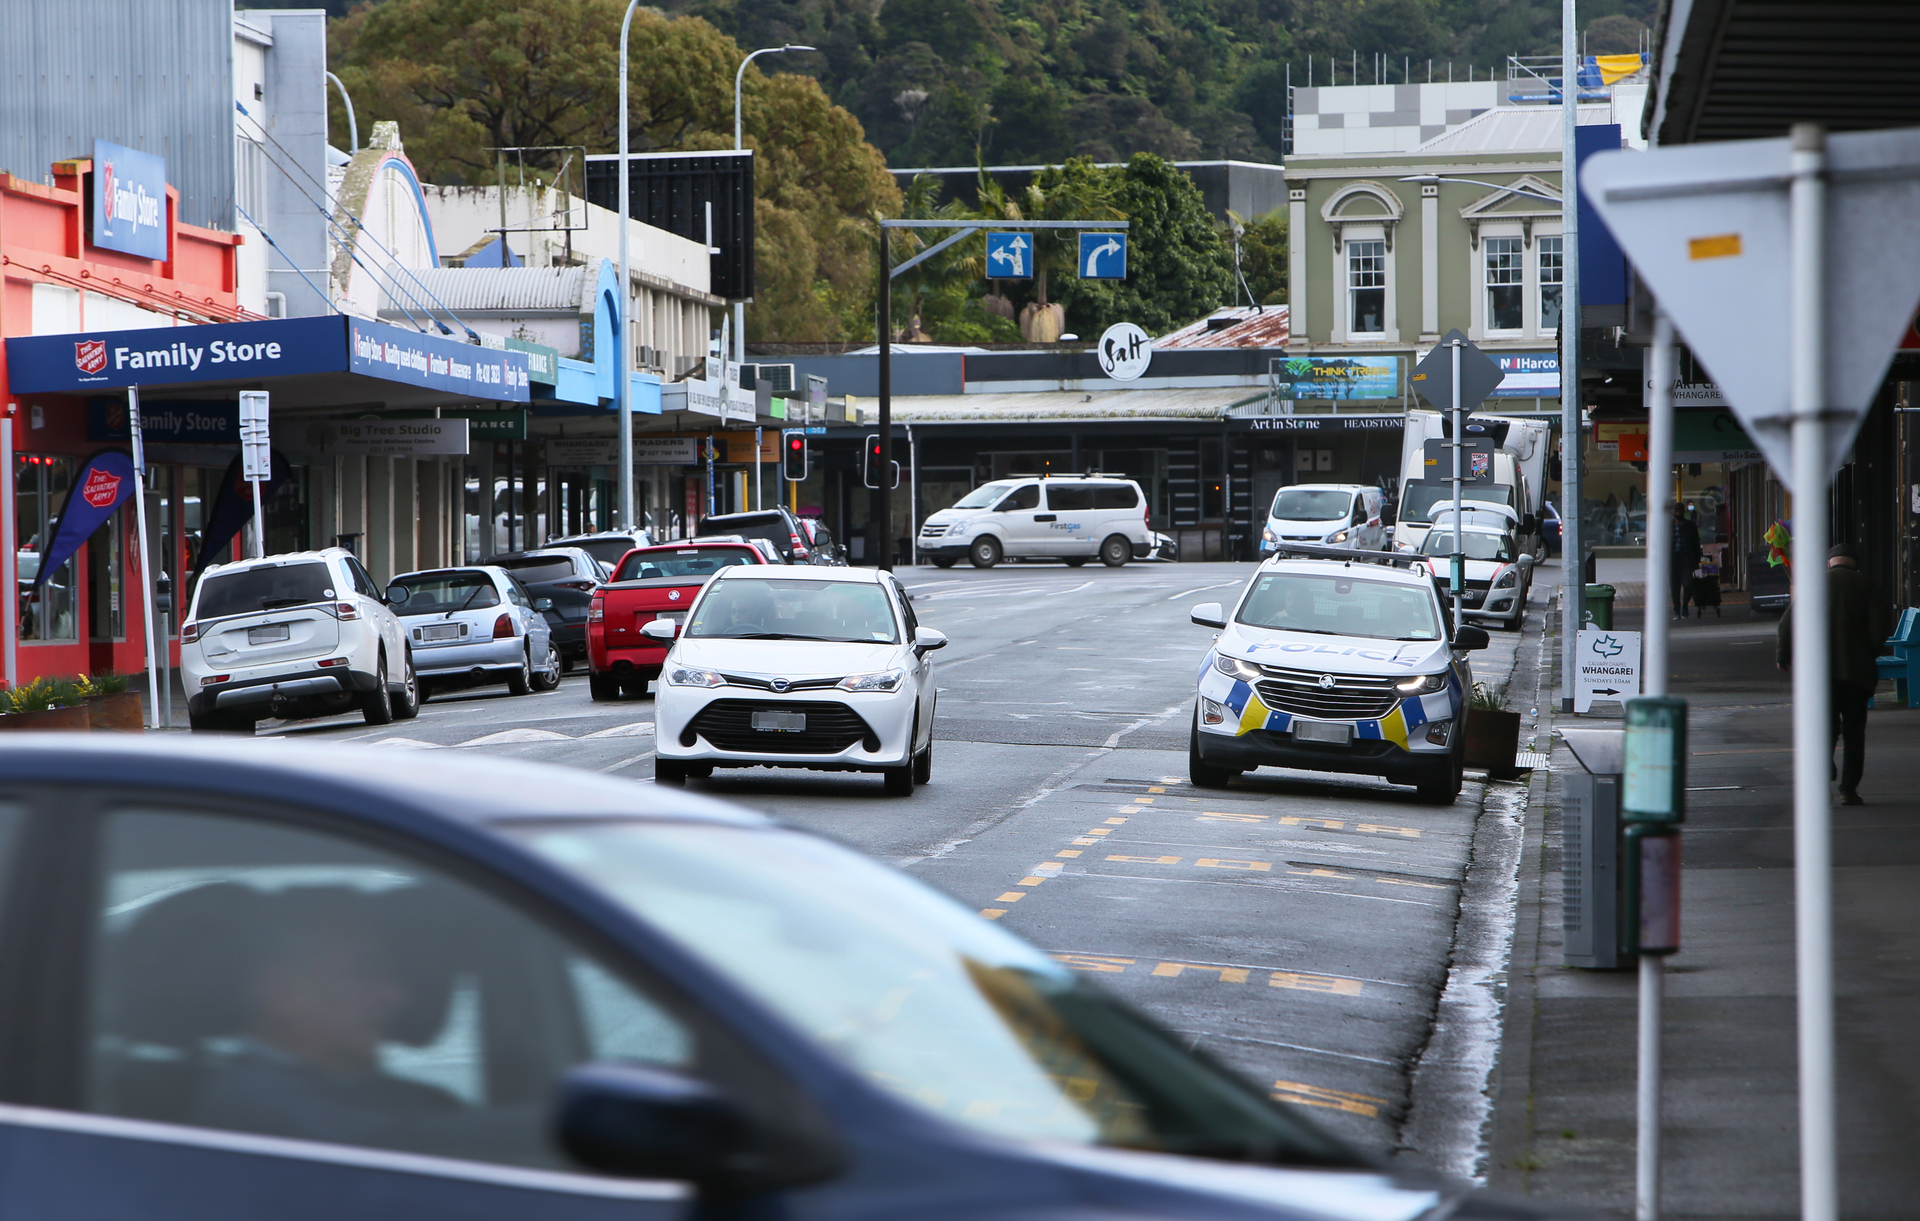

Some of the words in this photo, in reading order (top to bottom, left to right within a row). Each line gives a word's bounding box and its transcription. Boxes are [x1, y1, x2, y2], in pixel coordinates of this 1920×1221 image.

[113, 177, 138, 234] Family
[137, 184, 158, 228] Store
[77, 344, 103, 368] SALVATION
[80, 343, 93, 355] THE
[114, 342, 204, 372] Family
[210, 340, 282, 364] Store
[357, 334, 371, 365] Family
[371, 337, 382, 362] Store
[87, 354, 103, 371] ARMY
[384, 341, 400, 370] Quality
[400, 347, 411, 368] used
[411, 348, 427, 377] clothing
[528, 352, 547, 374] FINANCE
[1521, 357, 1559, 370] Harco
[1312, 366, 1347, 376] THINK
[1347, 366, 1390, 376] TREES
[140, 410, 183, 435] amily
[186, 412, 227, 431] Store
[1250, 418, 1270, 429] Art
[1272, 418, 1284, 429] in
[1285, 418, 1320, 429] Stone
[340, 425, 361, 437] Big
[365, 425, 395, 435] Tree
[399, 424, 442, 435] Studio
[554, 440, 609, 448] WHANGAREI
[93, 474, 107, 483] THE
[84, 480, 118, 495] SALVATION
[92, 490, 113, 502] ARMY
[1246, 643, 1421, 668] POLICE
[1582, 666, 1634, 676] WHANGAREI
